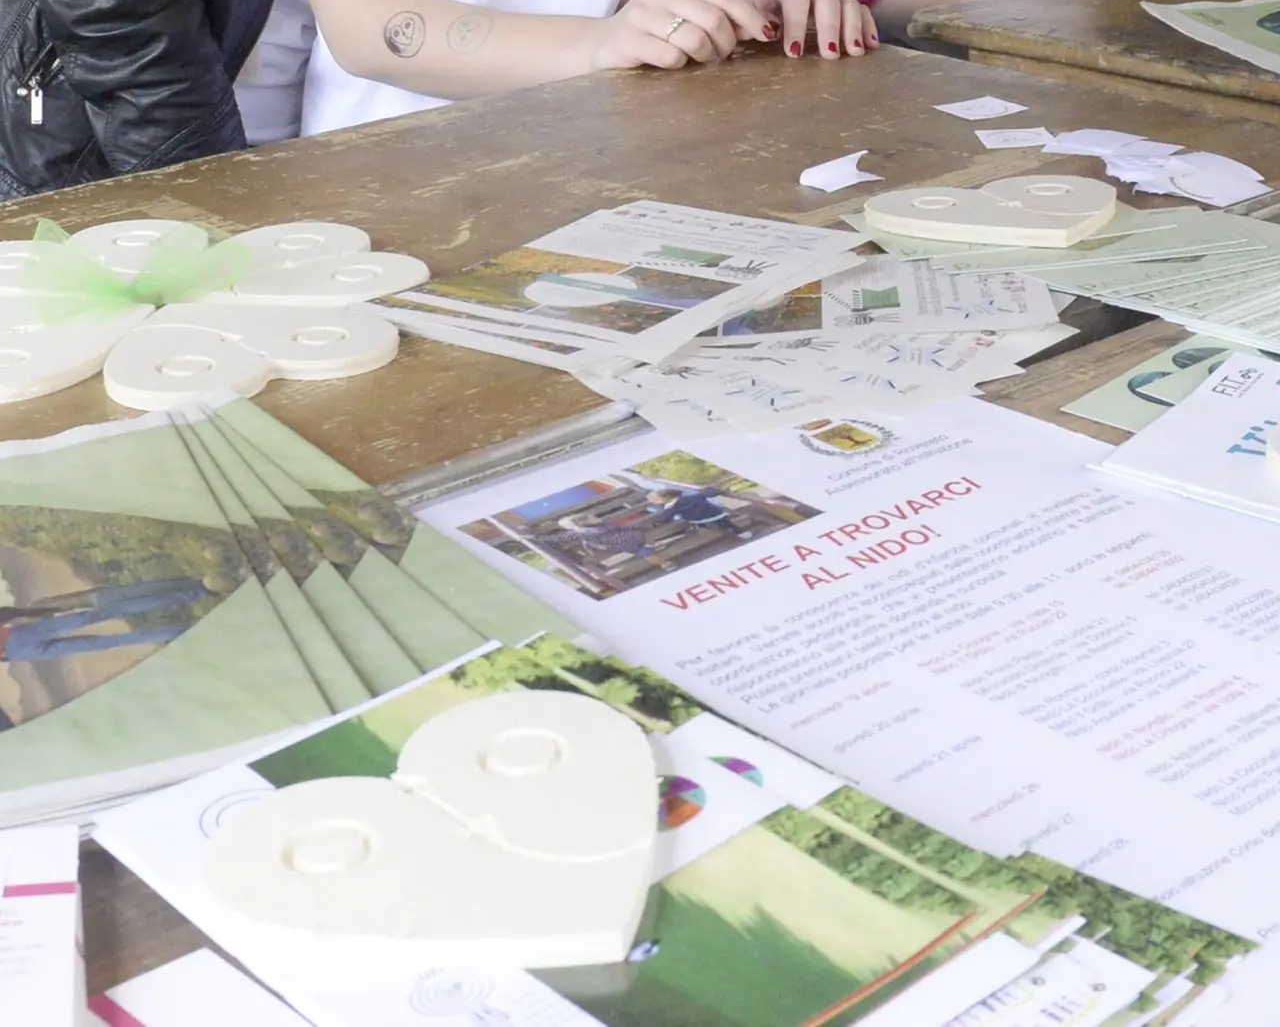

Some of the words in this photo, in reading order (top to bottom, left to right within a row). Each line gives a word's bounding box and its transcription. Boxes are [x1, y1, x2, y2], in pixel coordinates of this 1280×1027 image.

[664, 554, 789, 612] VENITE
[786, 543, 817, 561] A
[819, 476, 983, 547] TROVARCI
[795, 563, 845, 590] AL
[845, 523, 941, 568] NIDO!
